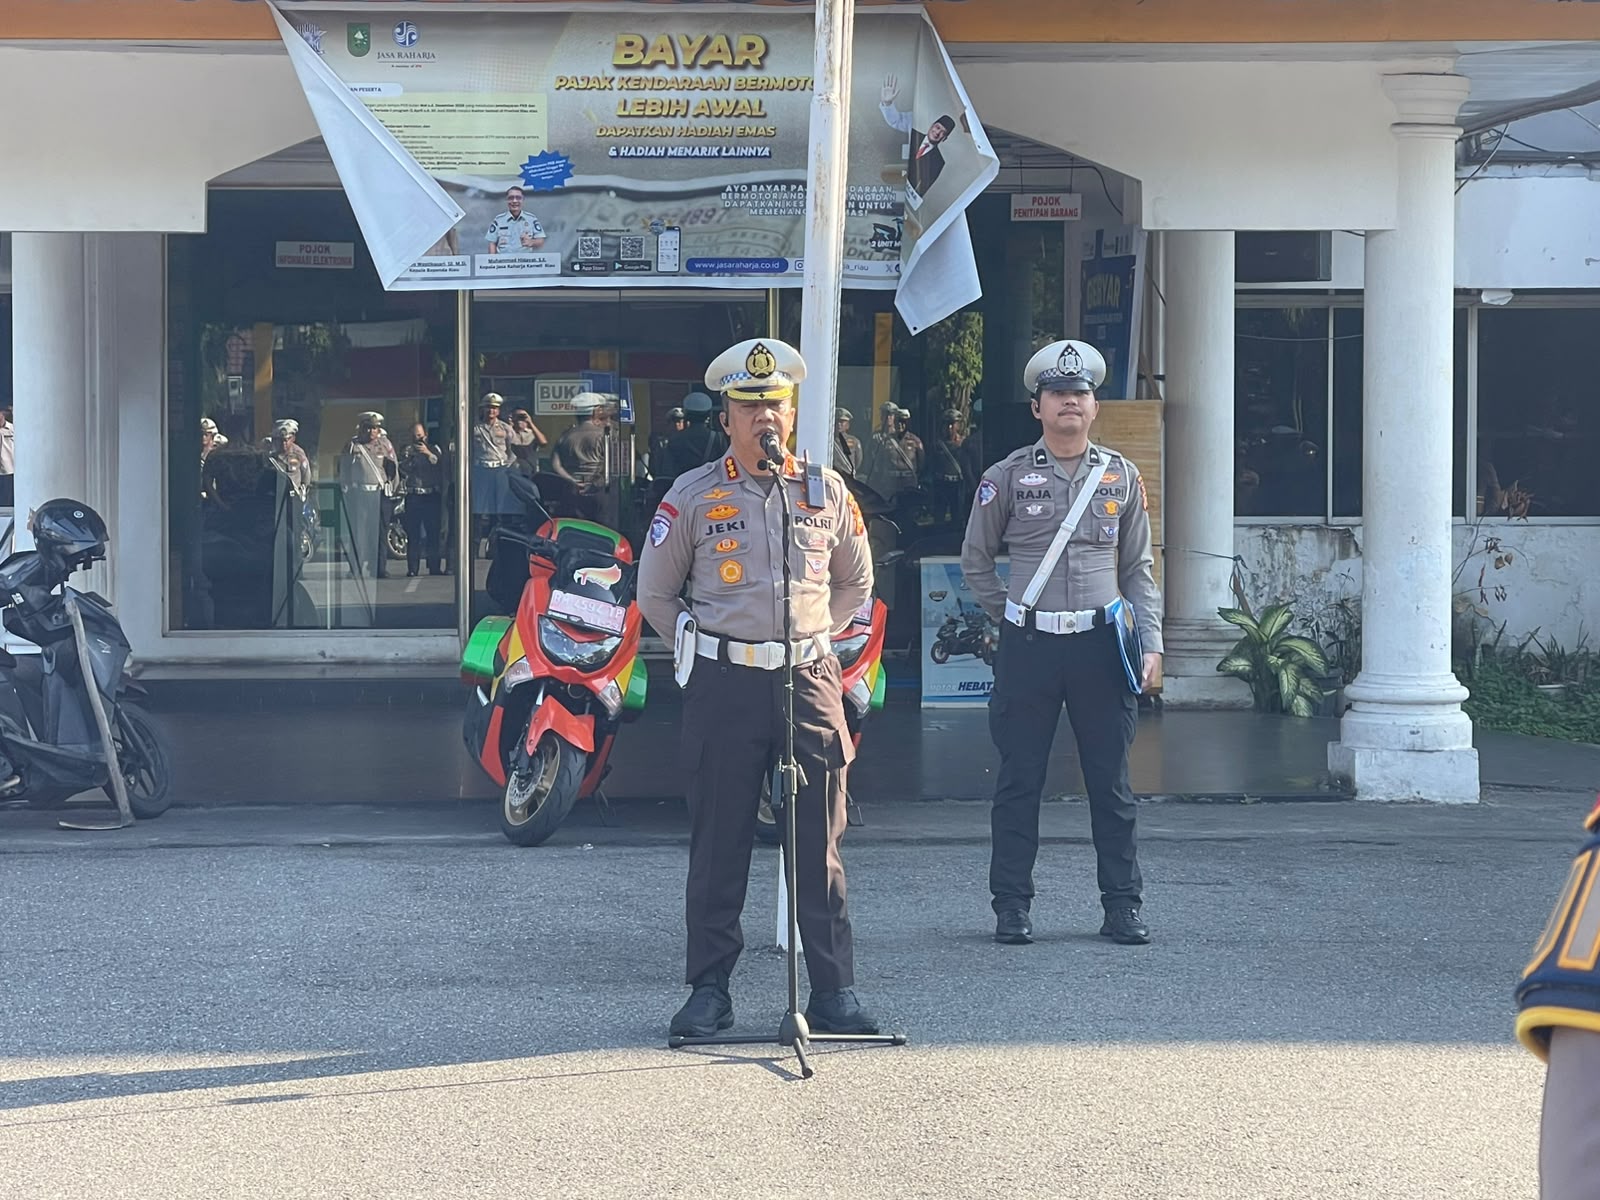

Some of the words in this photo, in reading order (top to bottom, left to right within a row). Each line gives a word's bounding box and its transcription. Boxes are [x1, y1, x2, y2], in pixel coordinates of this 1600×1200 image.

[613, 34, 767, 67] BAYAR
[555, 76, 614, 90] PAJAK
[618, 76, 730, 90] KENDARAAN
[616, 98, 688, 117] LEBIH
[693, 98, 767, 118] AWAL
[596, 126, 674, 137] DAPATKAN
[678, 126, 733, 137] HADIAH
[736, 126, 776, 137] EMAS
[608, 146, 617, 156] &
[620, 146, 665, 157] HADIAH
[667, 146, 720, 157] MENARIK
[722, 146, 771, 158] LAINNYA
[1032, 196, 1060, 206] POJOK
[1014, 208, 1048, 218] PENITIPAN
[1050, 208, 1078, 217] BARANG
[299, 245, 331, 254] POJOK
[695, 261, 779, 270] www.jasaraharja.co.id
[540, 385, 586, 399] BUKA
[1016, 489, 1051, 500] RAJA
[705, 520, 745, 536] JEKI
[795, 516, 831, 529] POLRI
[609, 606, 623, 618] TP
